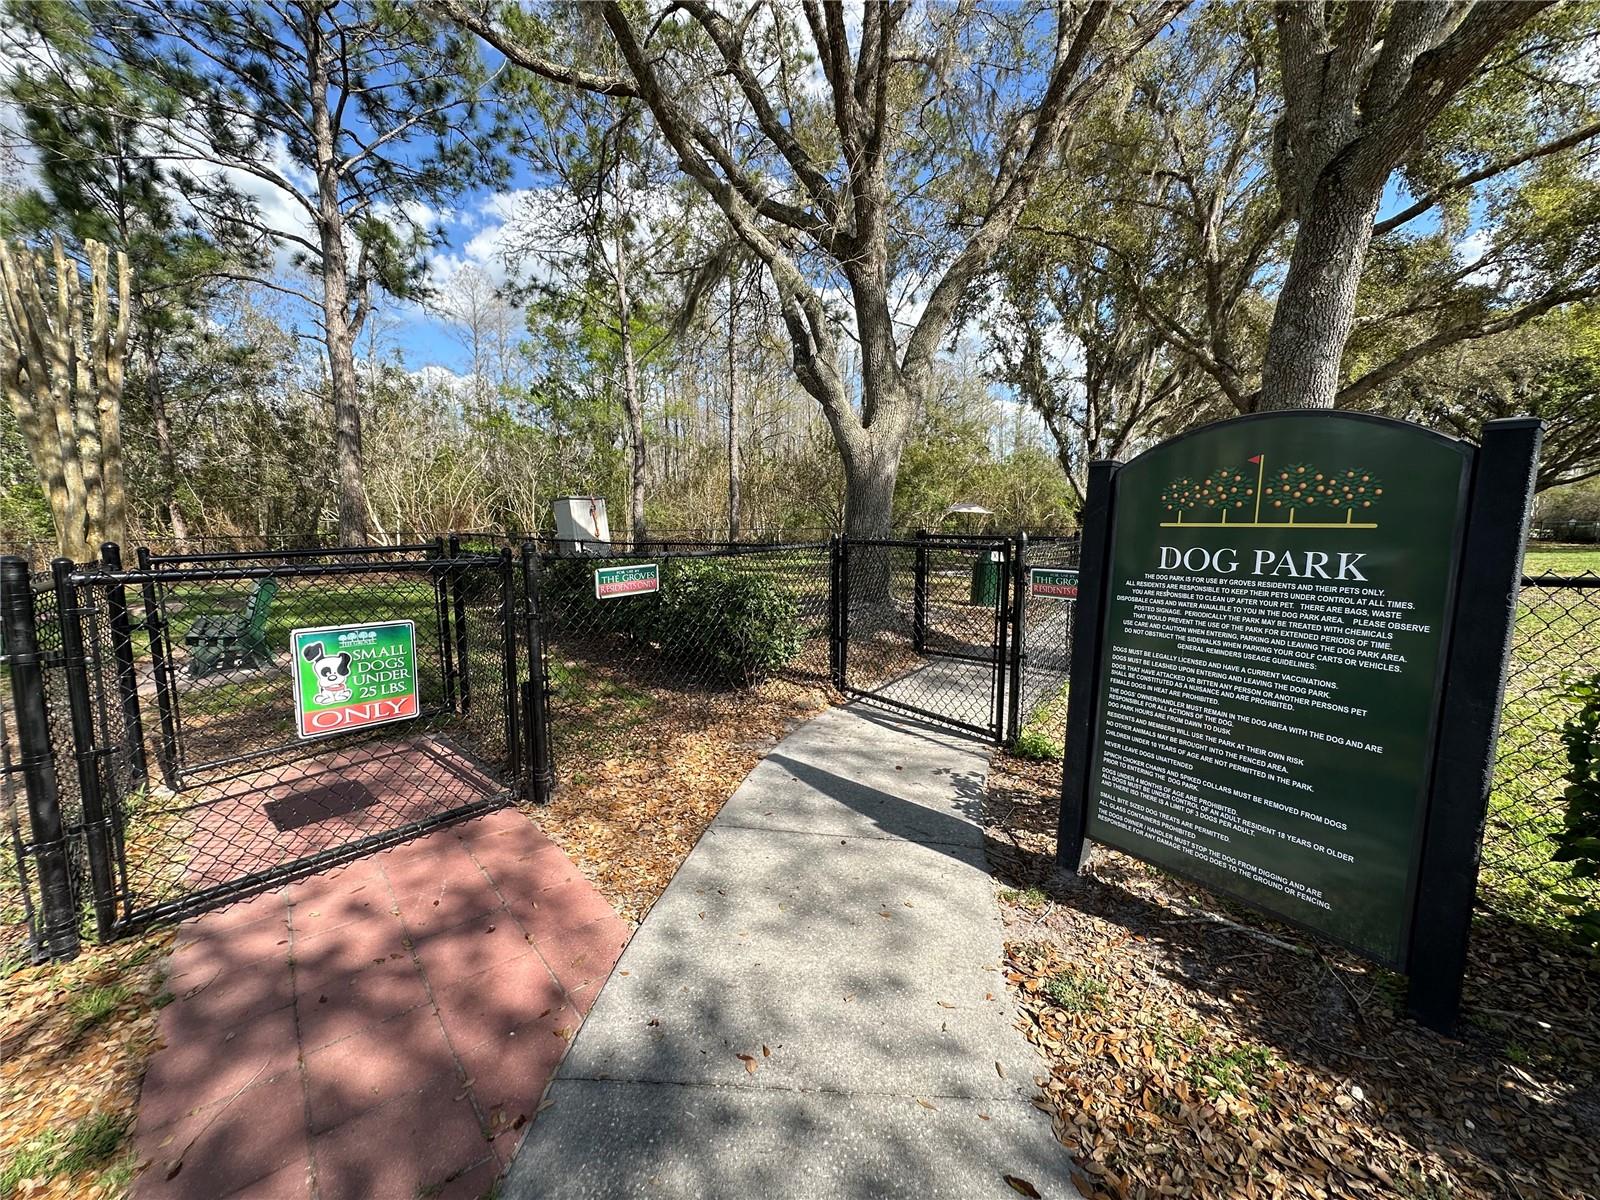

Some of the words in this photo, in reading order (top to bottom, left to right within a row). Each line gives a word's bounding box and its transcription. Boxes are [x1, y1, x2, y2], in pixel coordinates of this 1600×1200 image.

[1158, 545, 1239, 574] DOG
[1252, 549, 1368, 582] PARK
[600, 582, 637, 593] RESIDENTS
[637, 580, 654, 589] ONLY
[601, 576, 621, 584] THE
[622, 571, 655, 582] GROVES
[1033, 584, 1071, 594] RESIDENTS
[1035, 576, 1054, 584] THE
[1256, 581, 1296, 589] RESIDENTS
[1338, 586, 1361, 594] PETS
[1361, 588, 1385, 596] ONLY.
[1155, 590, 1194, 599] RESPONSIBLE
[1235, 597, 1257, 605] AFTER
[1258, 599, 1278, 607] YOUR
[1300, 603, 1325, 611] THERE
[1325, 605, 1343, 613] ARE
[1344, 607, 1371, 615] BAGS,
[1371, 609, 1402, 618] WASTE
[1178, 584, 1220, 592] RESPONSIBLE
[1316, 595, 1355, 604] CONTROL
[1385, 600, 1415, 609] TIMES.
[1167, 616, 1194, 625] PREVENT
[1244, 625, 1263, 633] PARK
[1279, 630, 1319, 640] EXTENDED
[1320, 634, 1356, 645] PERIODS
[1368, 640, 1392, 649] TIME.
[1184, 610, 1227, 620] PERIODICALLY
[1287, 621, 1322, 630] TREATED
[1322, 625, 1344, 633] WITH
[1344, 627, 1393, 638] CHEMICALS
[353, 644, 407, 660] SMALL
[1144, 630, 1174, 639] OBSTRUCT
[1186, 636, 1221, 646] SIDEWALKS
[1221, 640, 1241, 648] WHEN
[1242, 643, 1272, 653] PARKING
[1273, 648, 1293, 656] YOUR
[1294, 651, 1315, 659] GOLF
[1316, 654, 1343, 663] CARTS
[1344, 657, 1357, 665] OR
[1357, 659, 1402, 672] VEHICLES.
[1161, 624, 1186, 632] CAUTION
[1187, 627, 1205, 635] WHEN
[1205, 630, 1239, 639] ENTERING,
[1239, 634, 1269, 643] PARKING
[1286, 640, 1319, 650] LEAVING
[1318, 644, 1335, 652] THE
[1336, 646, 1356, 655] DOG
[1356, 649, 1380, 658] PARK
[1379, 652, 1407, 662] AREA.
[1176, 643, 1205, 652] GENERAL
[1205, 647, 1242, 657] REMINDERS
[1242, 653, 1271, 662] USEAGE
[1271, 657, 1317, 669] GUIDELINES:
[353, 669, 411, 685] UNDER
[357, 657, 405, 673] DOGS
[1151, 652, 1177, 661] LEGALLY
[1177, 656, 1207, 666] LICENSED
[1207, 661, 1221, 669] AND
[1222, 663, 1240, 672] HAVE
[1246, 667, 1280, 679] CURRENT
[1280, 673, 1338, 688] VACCINATIONS.
[360, 687, 376, 699] 25
[381, 682, 407, 695] LBS.
[312, 698, 408, 728] ONLY
[1185, 703, 1202, 712] MUST
[1203, 707, 1227, 717] REMAIN
[1236, 714, 1250, 722] THE
[1250, 717, 1266, 726] DOG
[1267, 721, 1288, 731] AREA
[1288, 726, 1307, 735] WITH
[1308, 730, 1324, 739] THE
[1325, 734, 1344, 744] DOG
[1344, 738, 1363, 748] AND
[1364, 742, 1383, 752] ARE
[1098, 806, 1108, 815] THE
[1108, 810, 1123, 821] DOGS
[1123, 816, 1143, 829] OWNER
[1146, 825, 1173, 840] HANDLER
[1173, 835, 1190, 847] MUST
[1190, 842, 1208, 854] STOP
[1207, 848, 1221, 859] THE
[1221, 853, 1237, 865] DOG
[1237, 860, 1257, 873] FROM
[1257, 867, 1288, 885] DIGGING
[1288, 879, 1305, 891] AND
[1305, 886, 1322, 898] ARE
